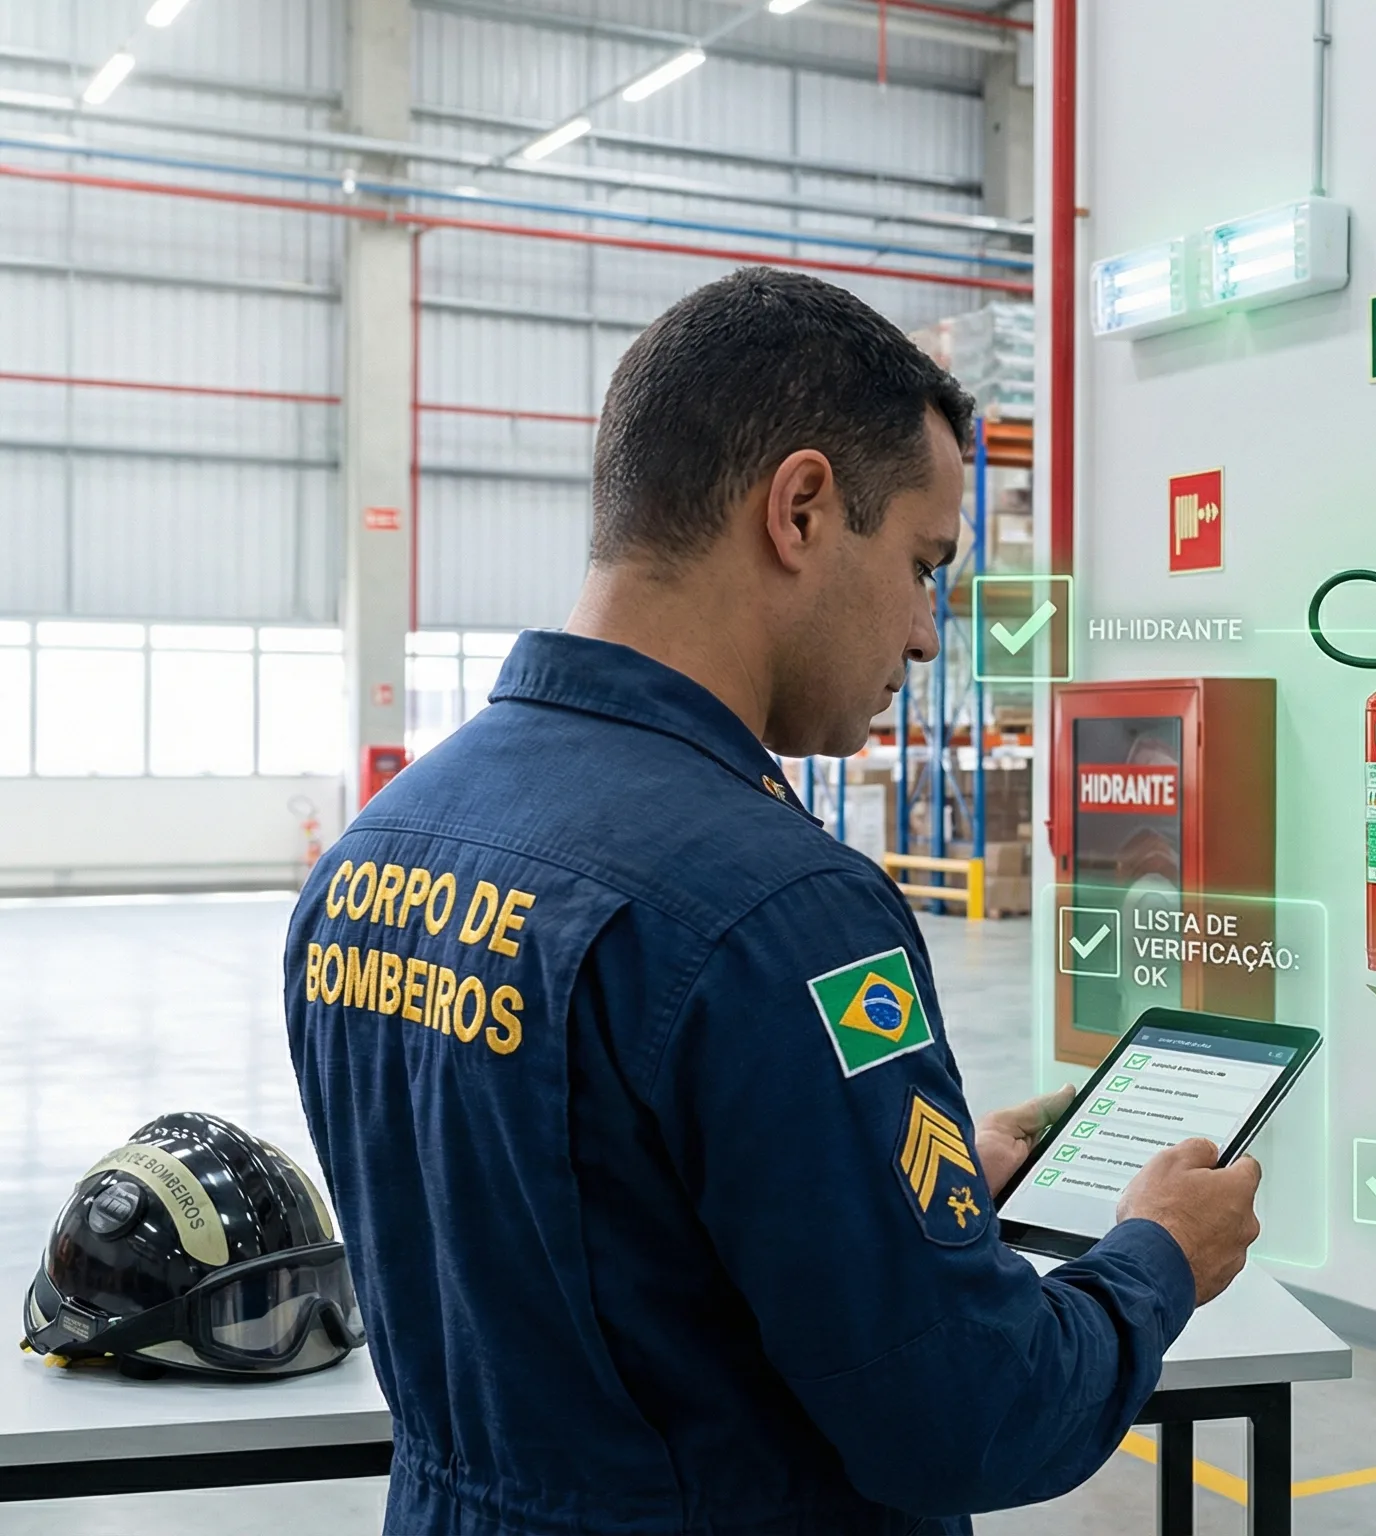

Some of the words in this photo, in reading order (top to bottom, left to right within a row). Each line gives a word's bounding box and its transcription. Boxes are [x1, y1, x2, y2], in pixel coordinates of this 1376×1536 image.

[1080, 773, 1176, 806] HIDRANTE
[326, 860, 456, 936] CORPO
[458, 880, 536, 957] DE
[306, 943, 525, 1055] BOMBEIROS
[143, 1158, 206, 1231] BOMBEIROS
